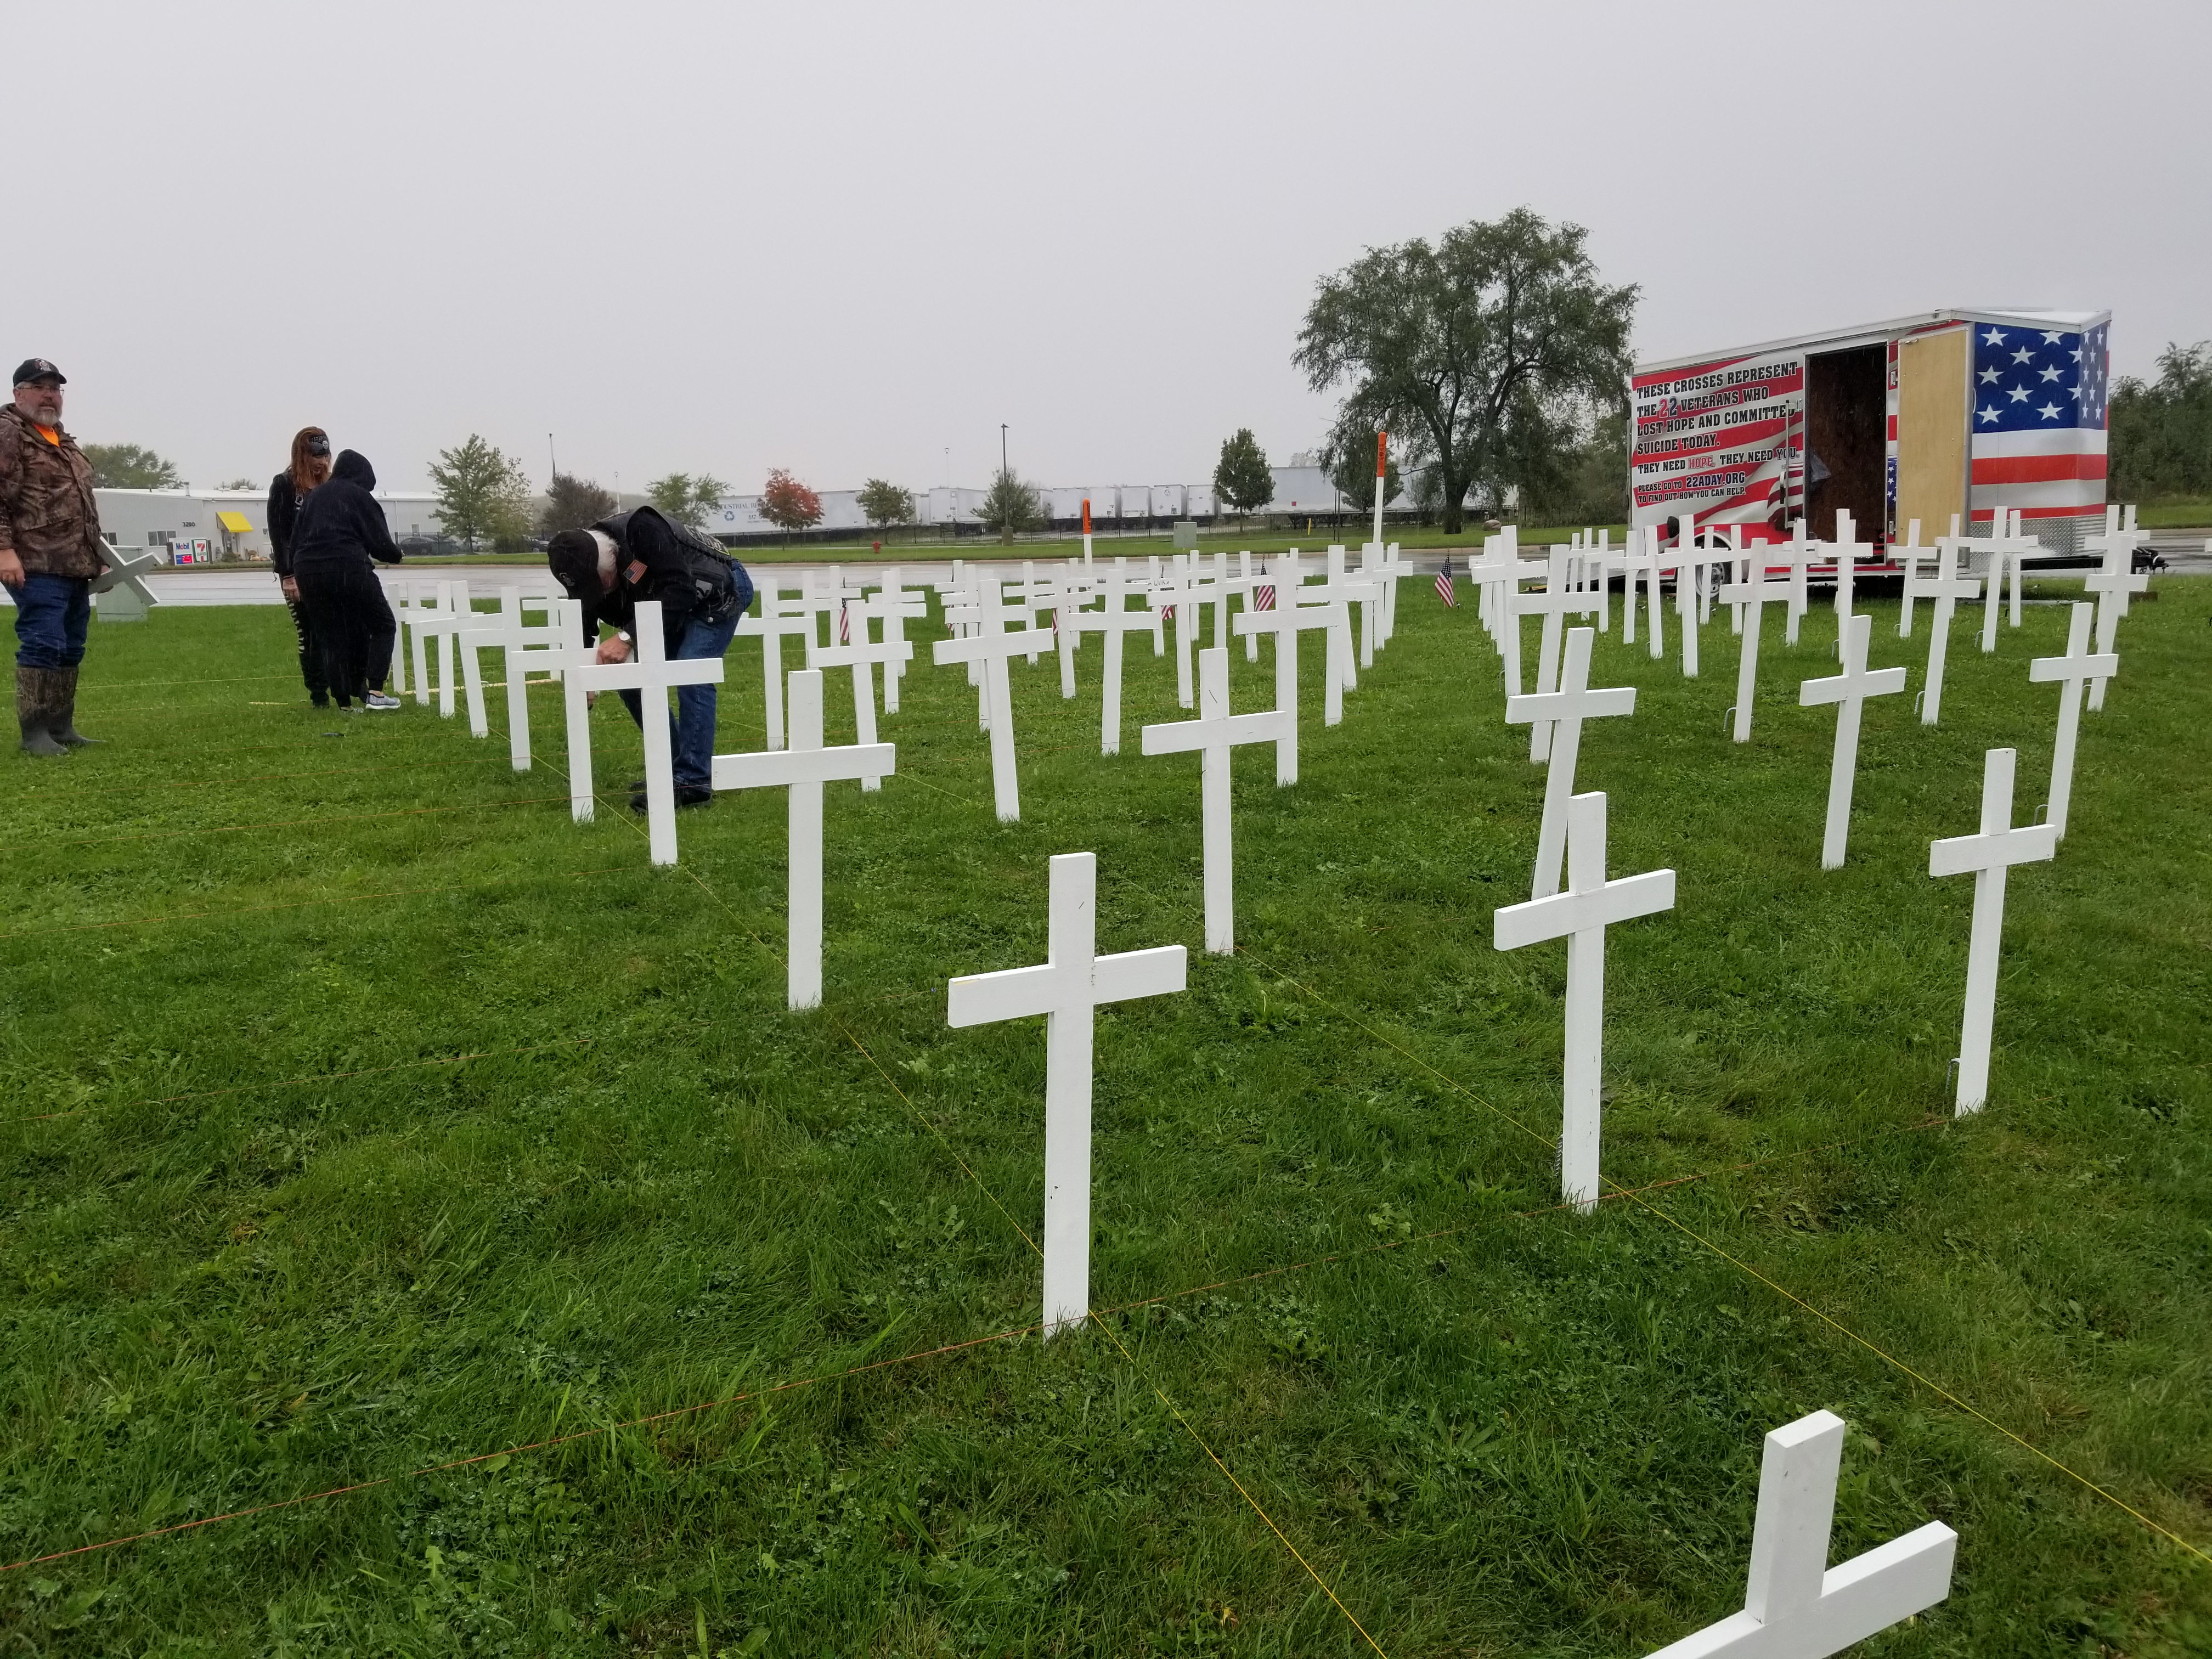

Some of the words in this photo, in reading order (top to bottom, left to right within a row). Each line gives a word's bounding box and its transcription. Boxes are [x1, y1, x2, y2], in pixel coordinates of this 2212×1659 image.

[1637, 383, 1670, 399] THESE
[1674, 374, 1723, 392] CROSSES
[1727, 362, 1798, 385] REPRESENT
[1637, 403, 1657, 417] THE
[1660, 397, 1678, 417] 22
[1680, 391, 1739, 412] VETERANS
[1743, 386, 1769, 402] WHO
[1637, 421, 1663, 436] LOST
[1667, 417, 1694, 432] HOPE
[1699, 414, 1720, 428] AND
[1638, 439, 1678, 455] SUICIDE
[1681, 433, 1720, 450] TODAY.
[1638, 462, 1660, 474] THEY
[1662, 459, 1685, 471] NEED
[1689, 456, 1716, 469] HOPE.
[1719, 453, 1744, 466] THEY
[1748, 450, 1773, 462] NEED
[1638, 482, 1661, 493] PLEASE
[1663, 482, 1672, 490] GO
[1686, 472, 1745, 488] 22ADAY.ORG
[1648, 494, 1662, 502] FIND
[1664, 492, 1677, 501] OUT
[1679, 490, 1694, 500] HOW
[1696, 490, 1709, 498] YOU
[1711, 488, 1724, 497] CAN
[1726, 487, 1746, 495] HELP.
